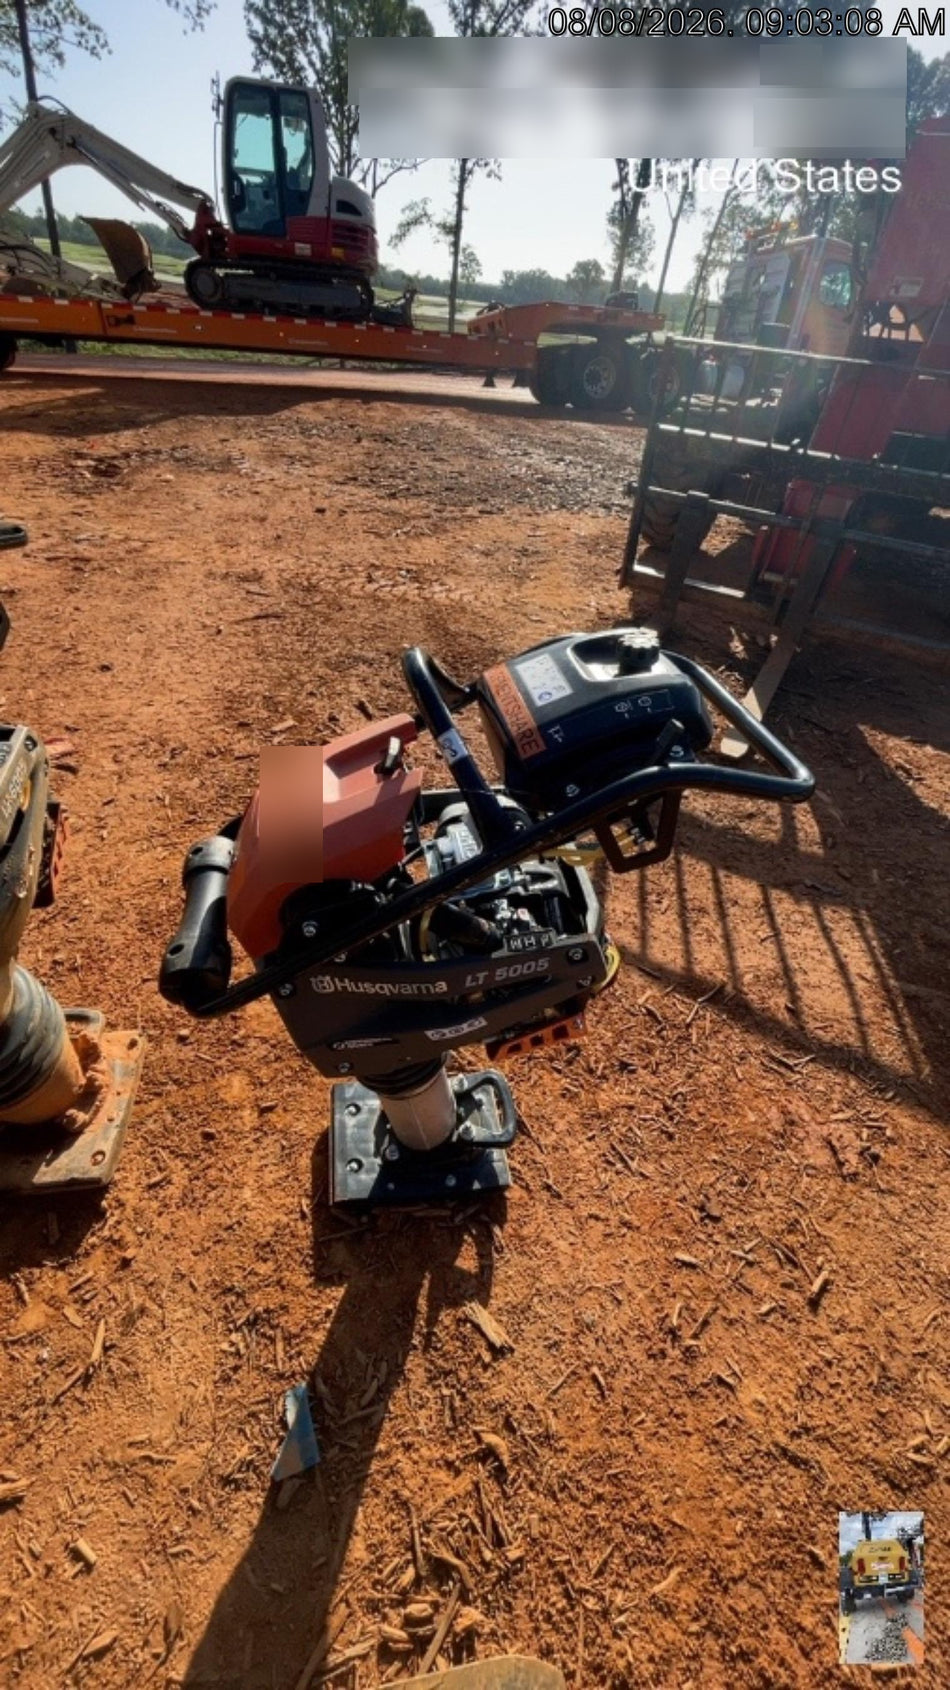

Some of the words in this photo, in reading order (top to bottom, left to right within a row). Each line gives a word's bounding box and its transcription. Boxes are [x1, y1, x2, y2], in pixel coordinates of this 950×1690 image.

[465, 971, 489, 988] LT
[495, 957, 550, 981] 5005
[334, 977, 448, 996] Husqvarna
